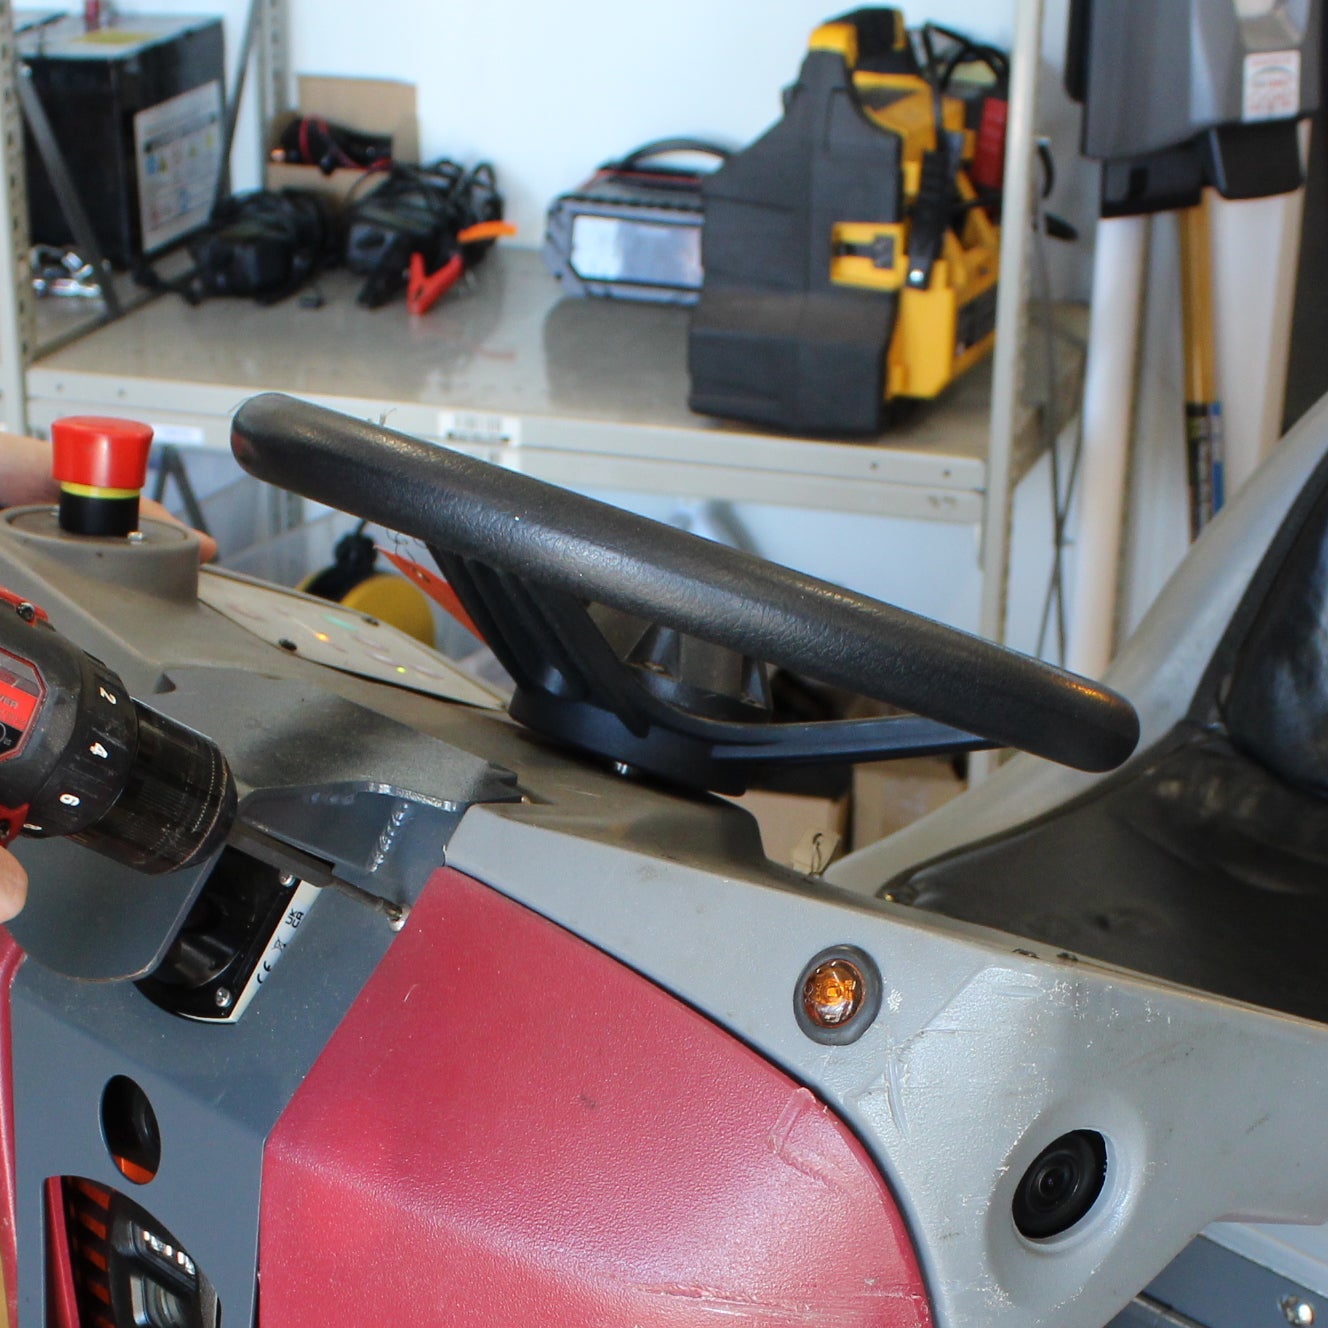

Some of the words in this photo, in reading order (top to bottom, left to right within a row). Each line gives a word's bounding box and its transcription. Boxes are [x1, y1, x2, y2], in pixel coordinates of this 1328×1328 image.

[99, 686, 117, 705] 2
[89, 742, 108, 759] 4
[60, 793, 80, 807] 6
